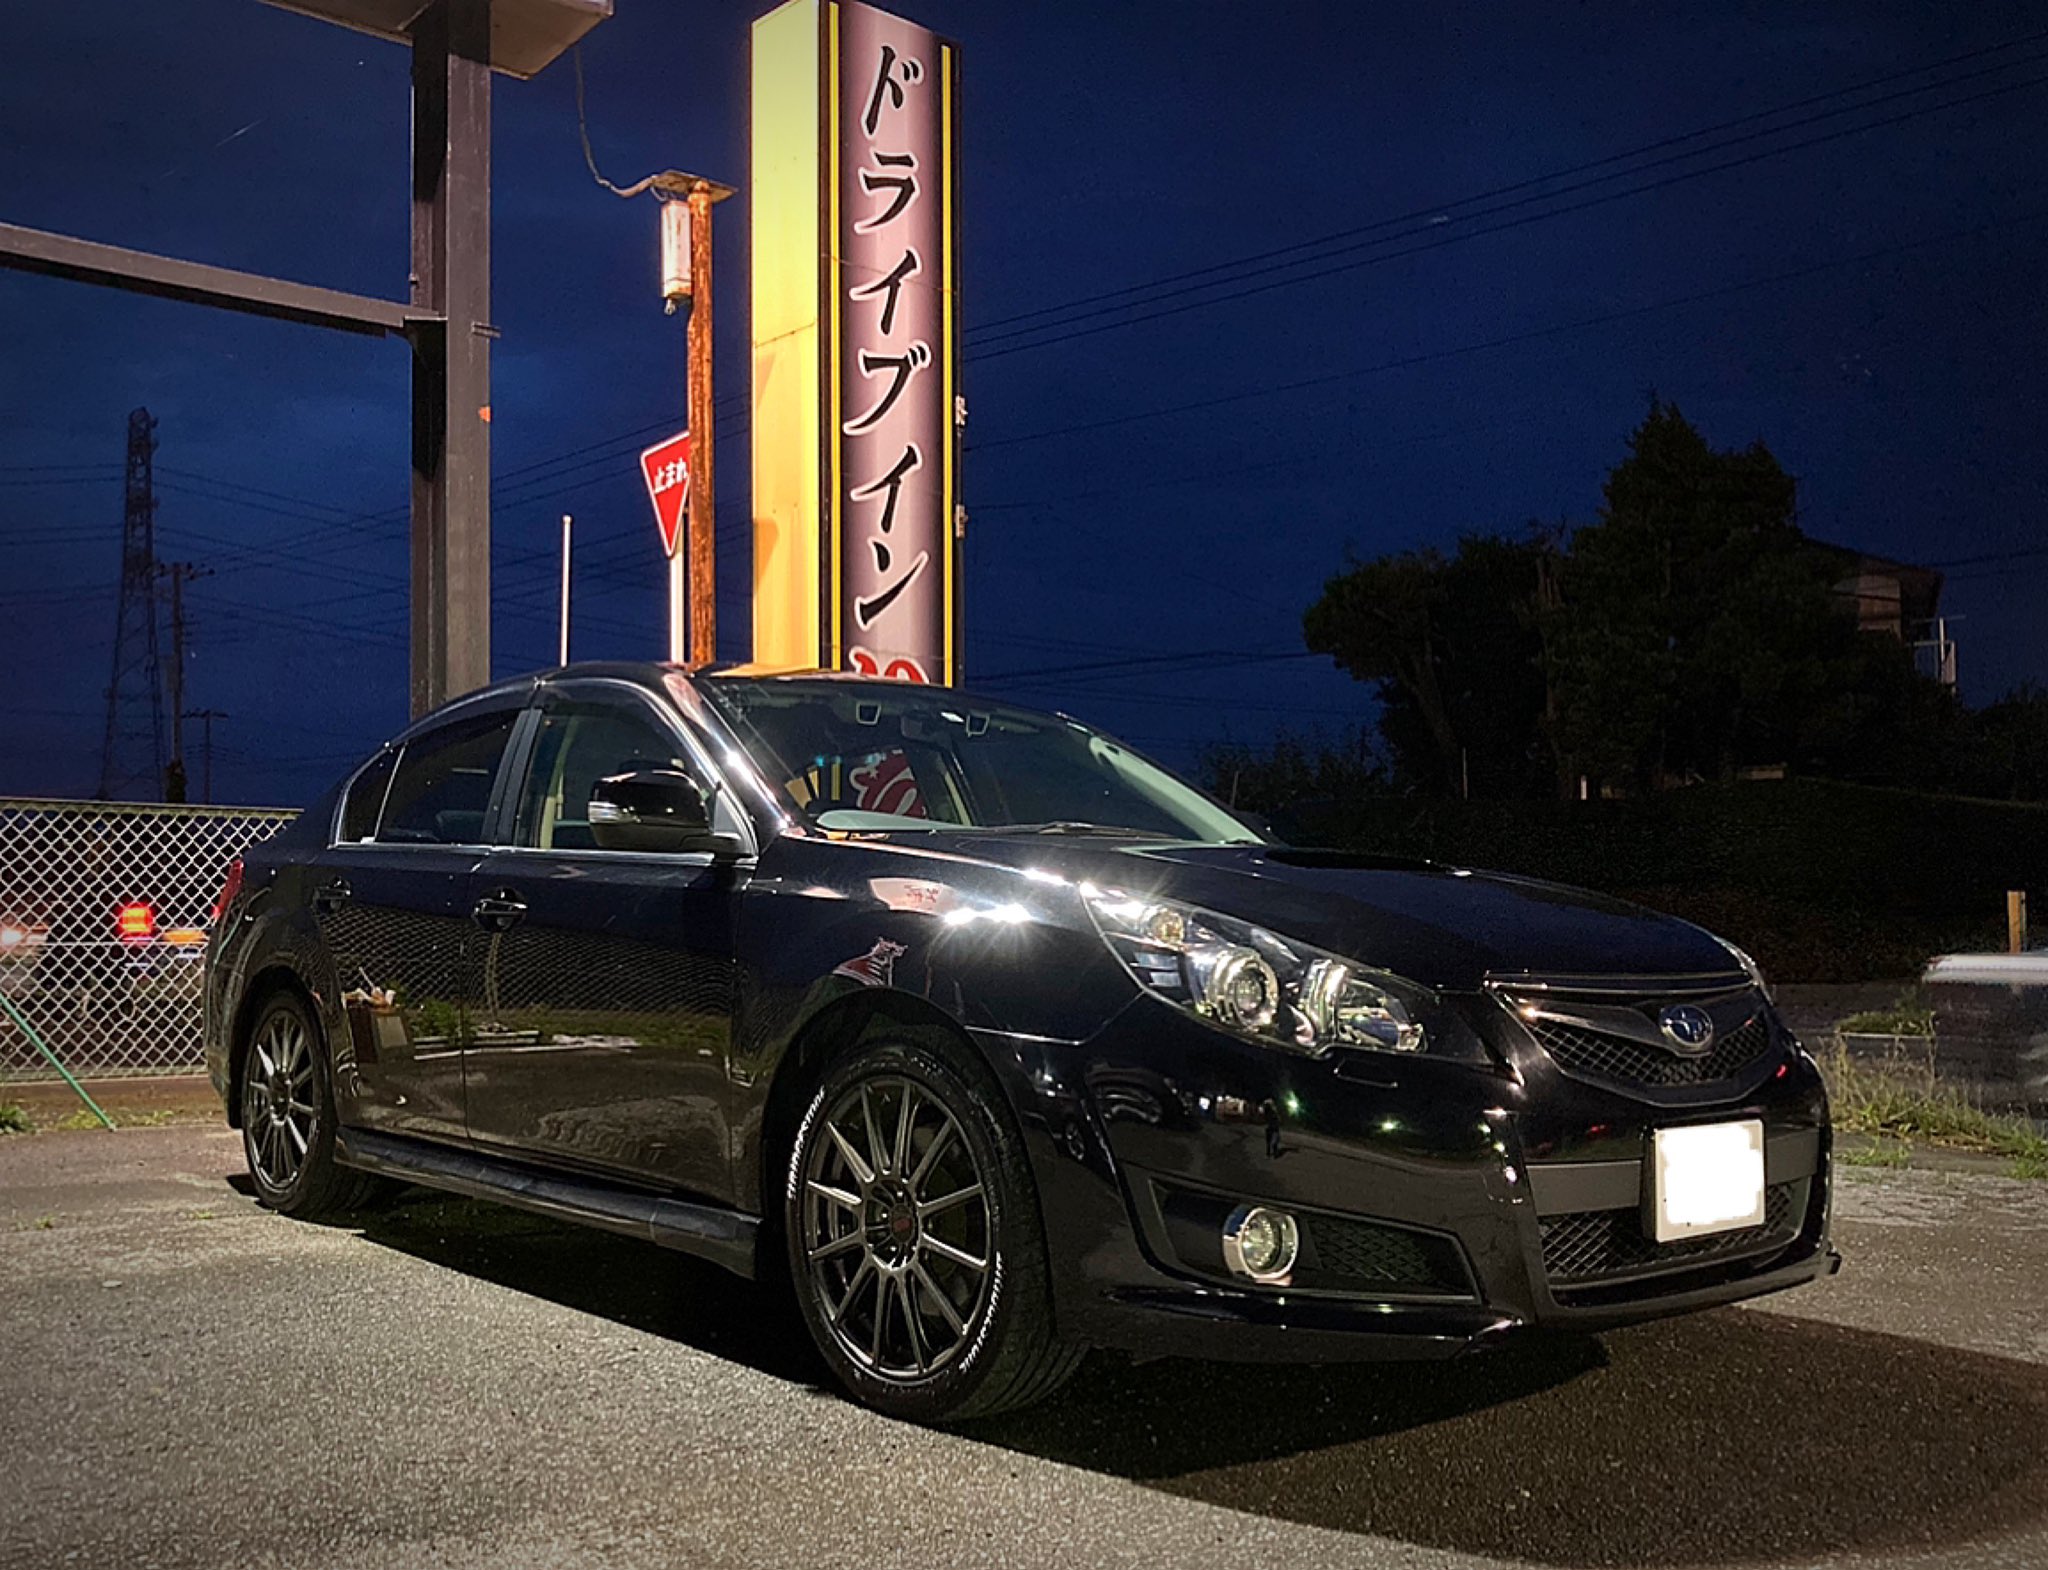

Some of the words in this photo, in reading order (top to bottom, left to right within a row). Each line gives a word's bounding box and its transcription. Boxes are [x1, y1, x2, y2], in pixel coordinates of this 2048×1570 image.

[844, 45, 930, 628] ドライブイン
